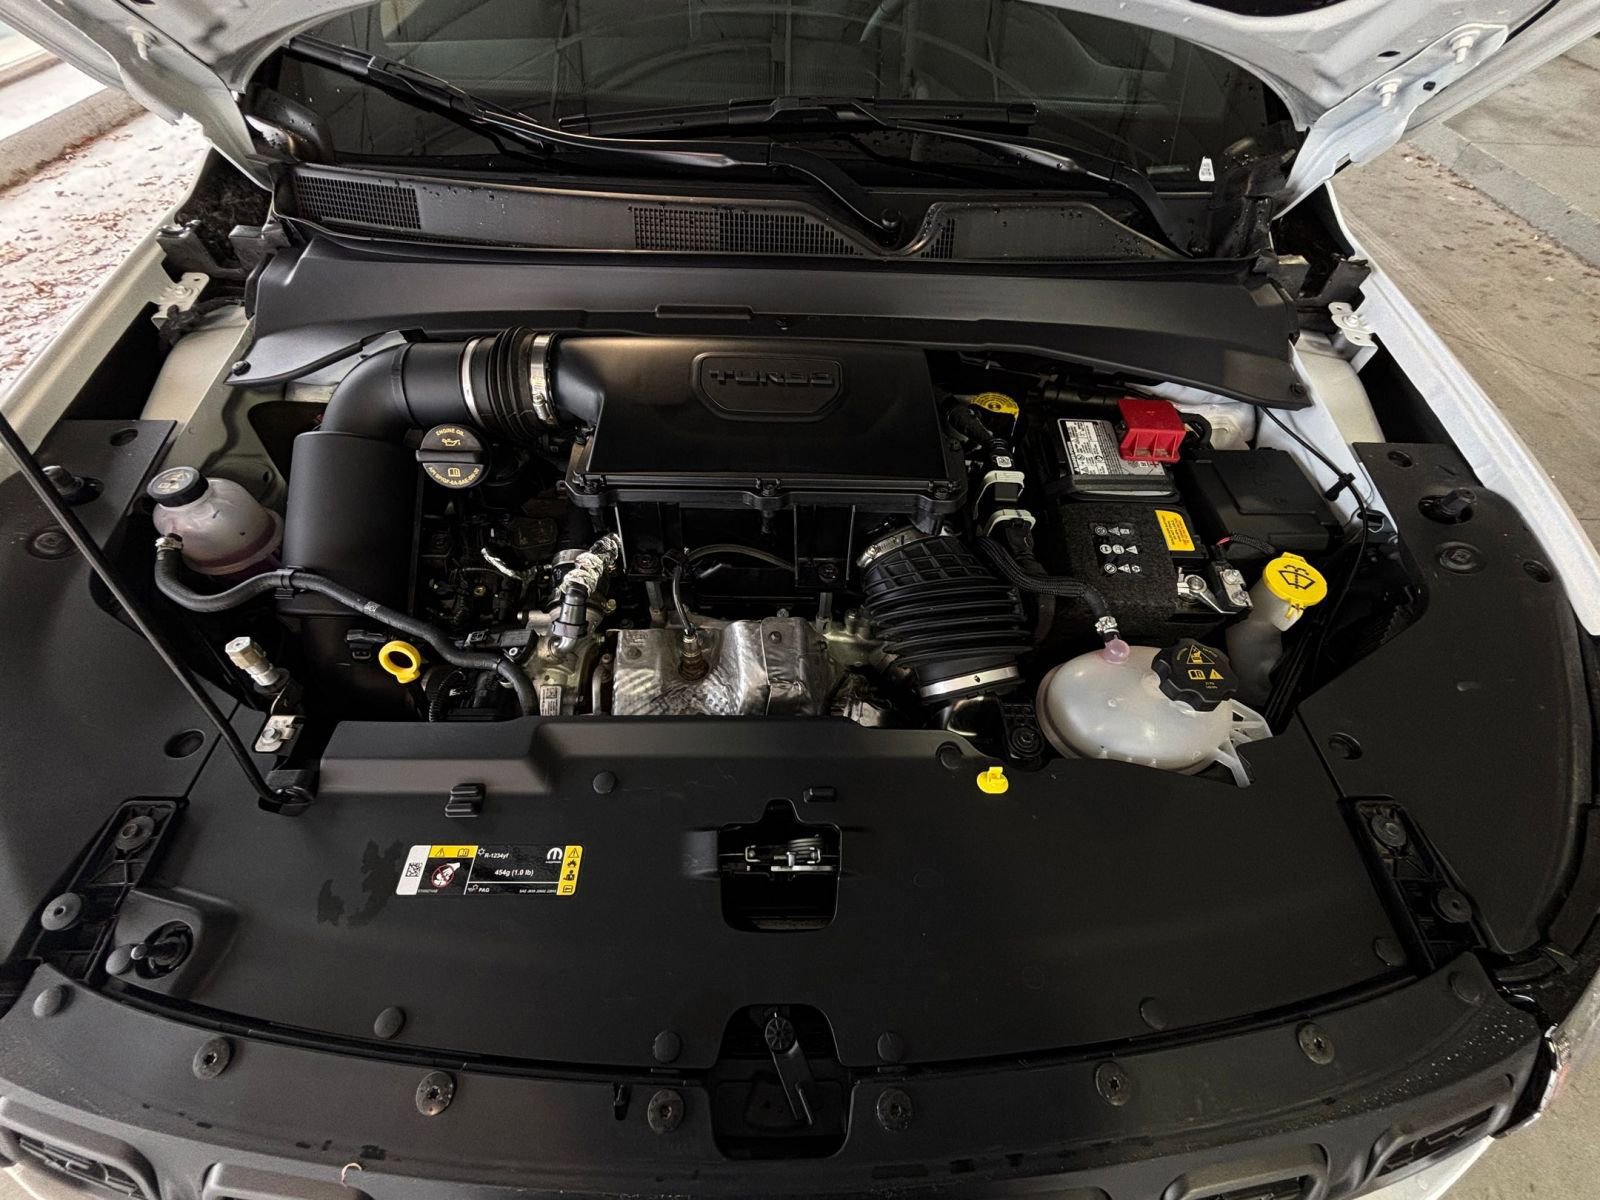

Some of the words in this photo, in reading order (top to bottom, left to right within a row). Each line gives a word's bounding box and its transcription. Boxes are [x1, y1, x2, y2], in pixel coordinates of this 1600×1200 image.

[435, 428, 455, 436] ENGINE
[456, 429, 465, 437] OIL
[494, 869, 510, 877] 454g
[511, 869, 524, 877] (1.0
[524, 869, 534, 877] lb)
